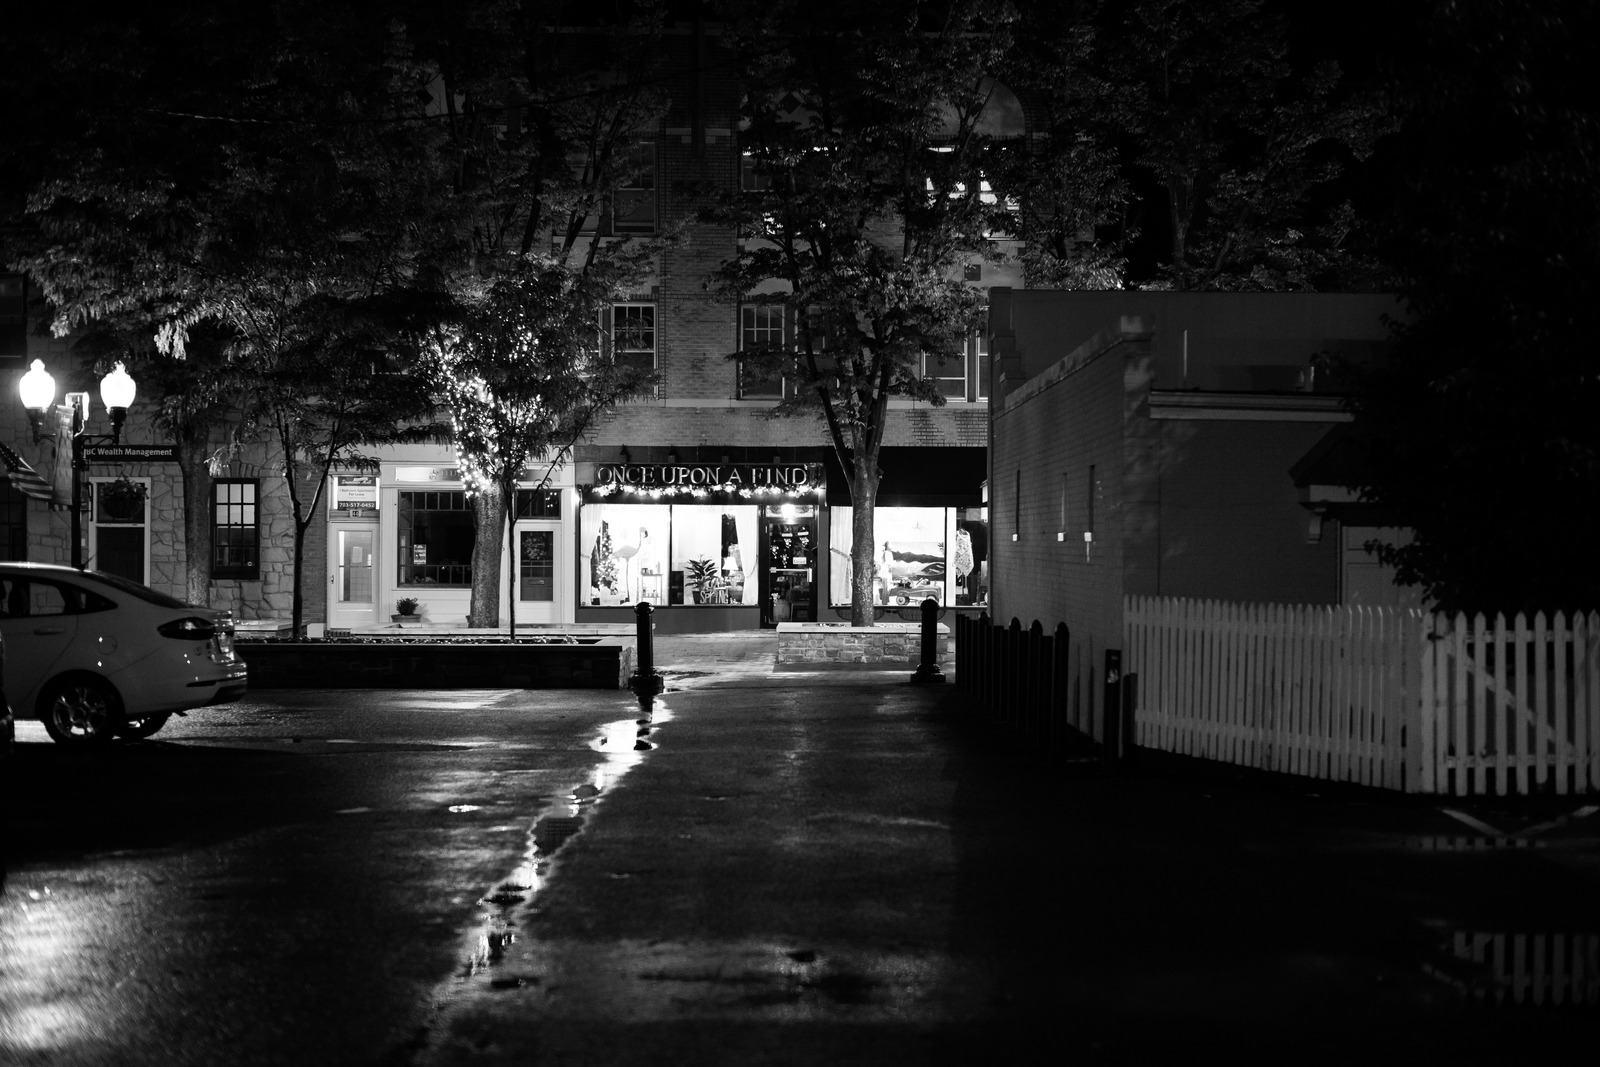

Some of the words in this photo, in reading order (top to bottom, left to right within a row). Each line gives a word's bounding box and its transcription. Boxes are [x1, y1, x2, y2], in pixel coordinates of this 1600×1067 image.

[124, 448, 172, 457] Management
[597, 466, 655, 483] ONCE
[661, 466, 721, 484] UPON
[728, 467, 742, 483] A
[751, 467, 807, 485] FIND
